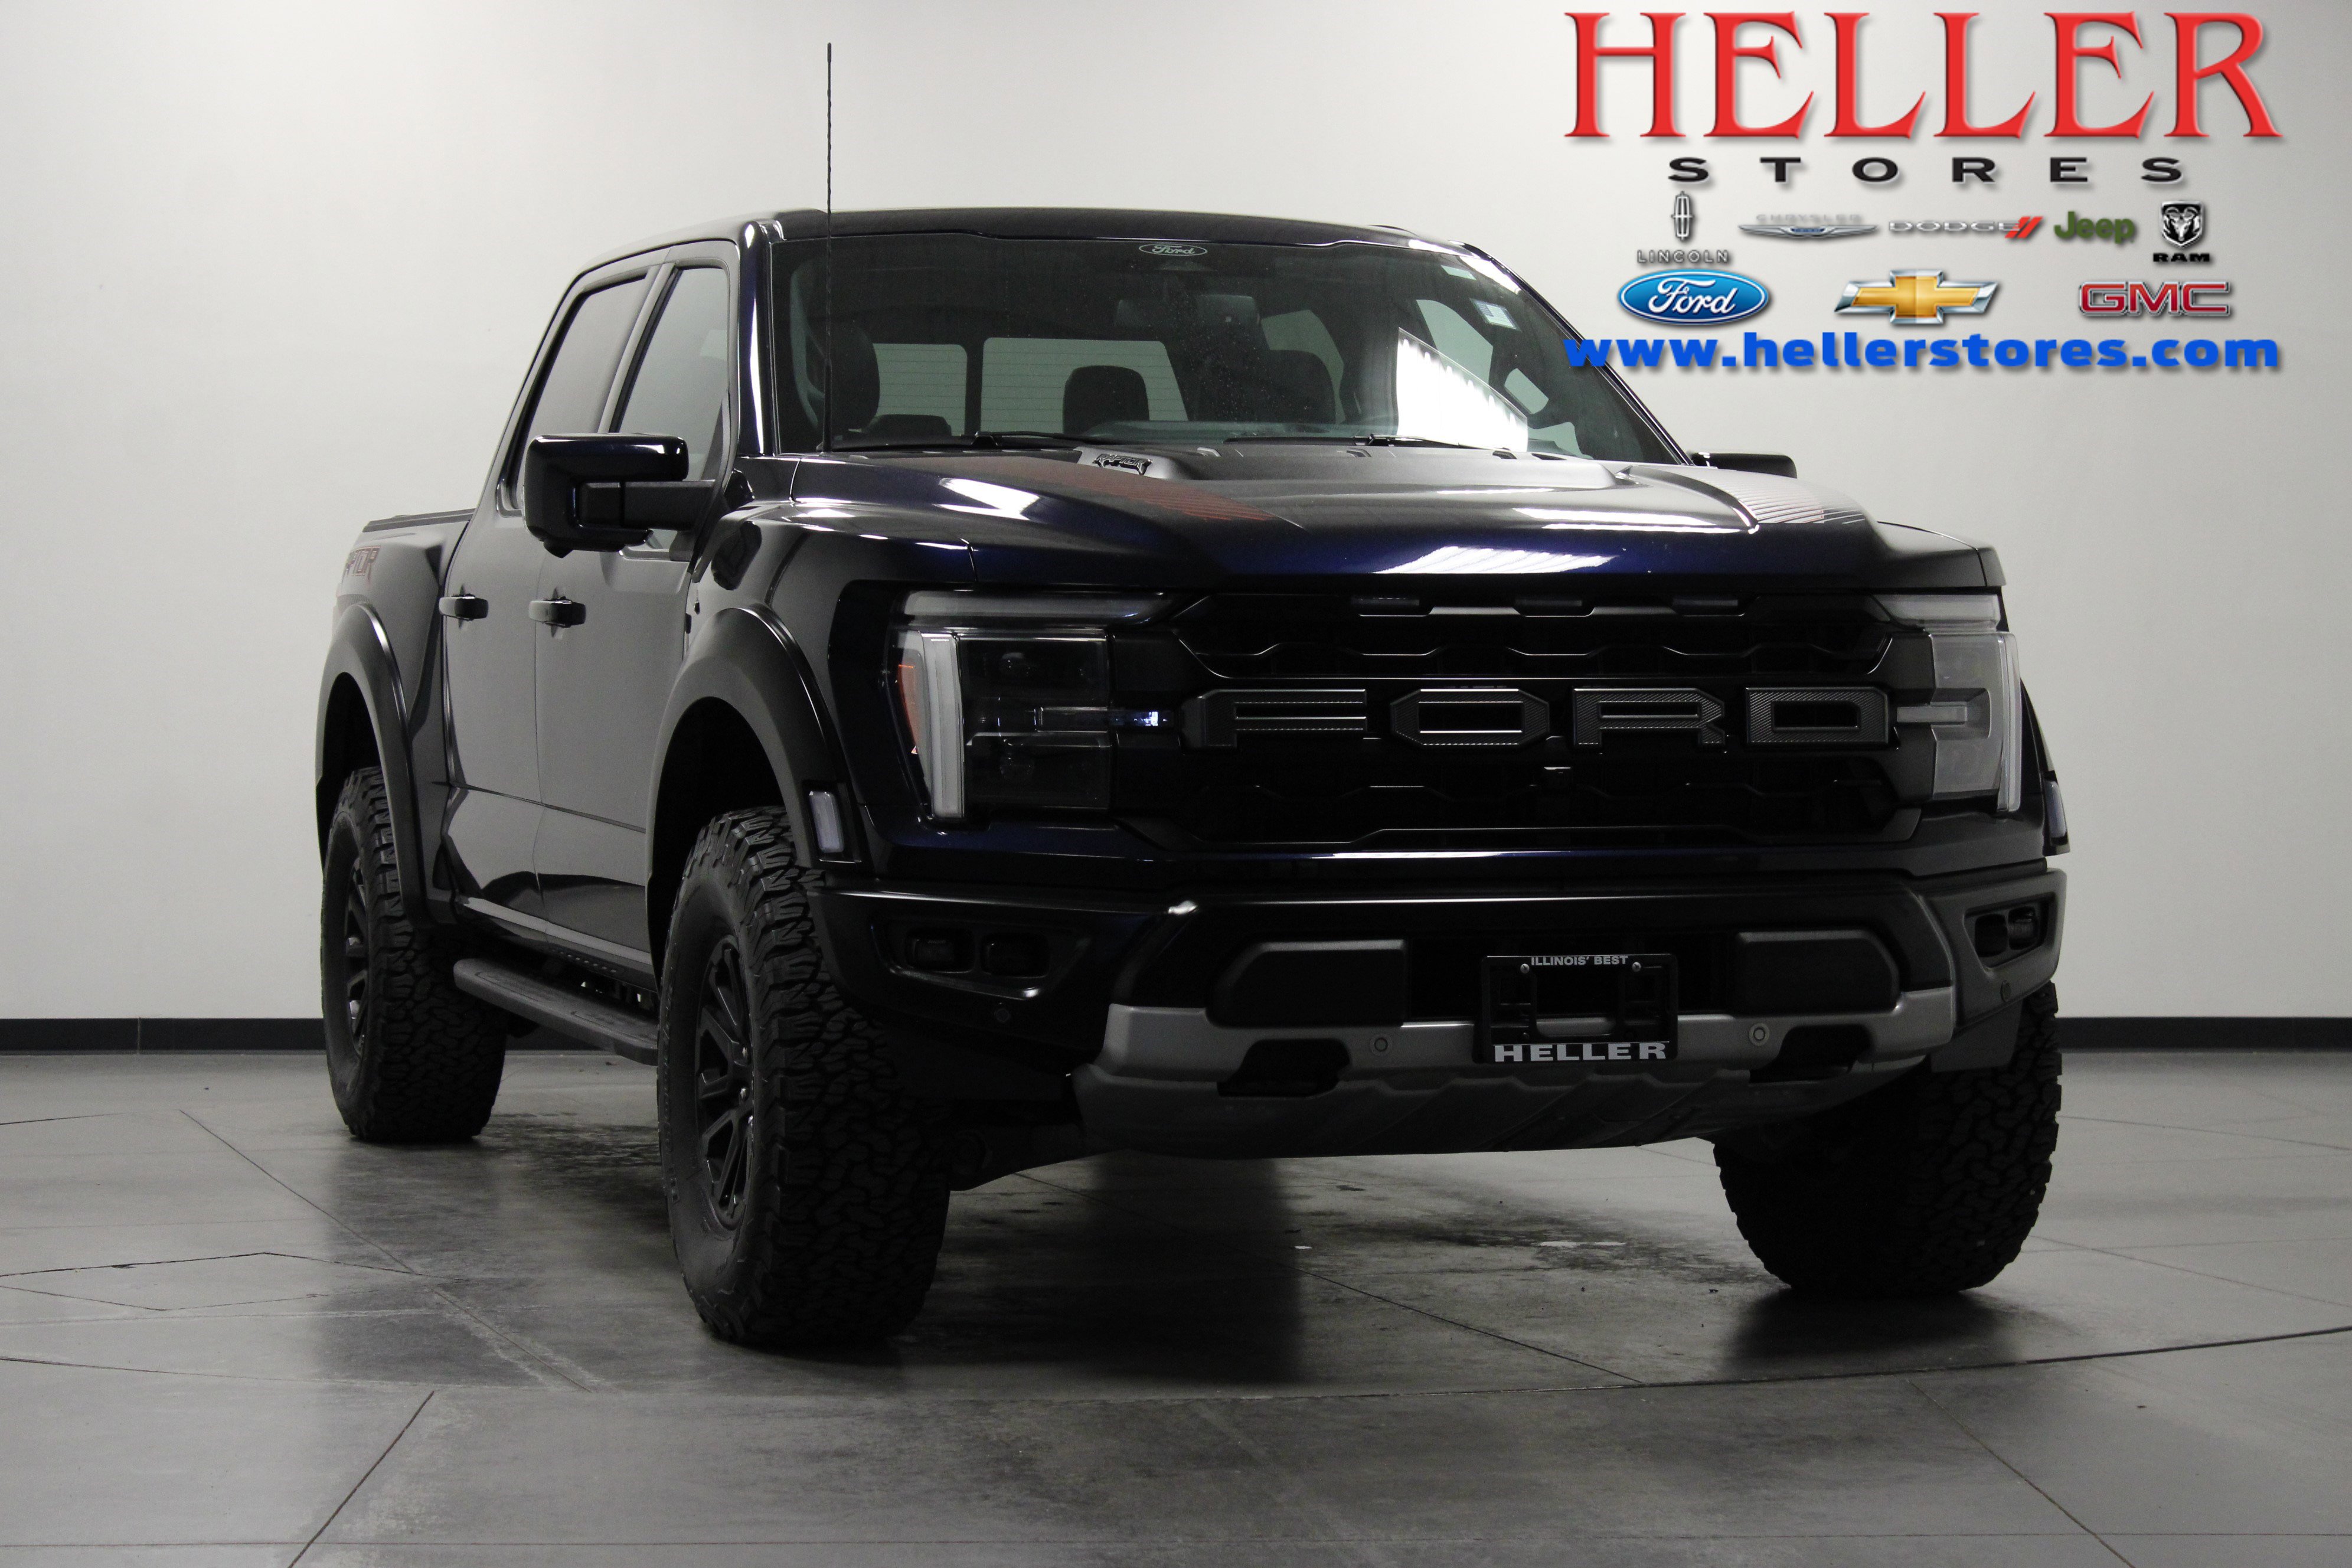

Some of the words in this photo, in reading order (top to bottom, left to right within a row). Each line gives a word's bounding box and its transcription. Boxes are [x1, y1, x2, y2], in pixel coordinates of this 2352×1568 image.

[1152, 244, 1195, 254] Ford
[1092, 453, 1152, 475] RAPTOR
[1182, 687, 1889, 749] FORD
[1531, 956, 1589, 966] ILLINOIS'
[1594, 955, 1628, 965] BEST
[1494, 1043, 1667, 1063] HELLER
